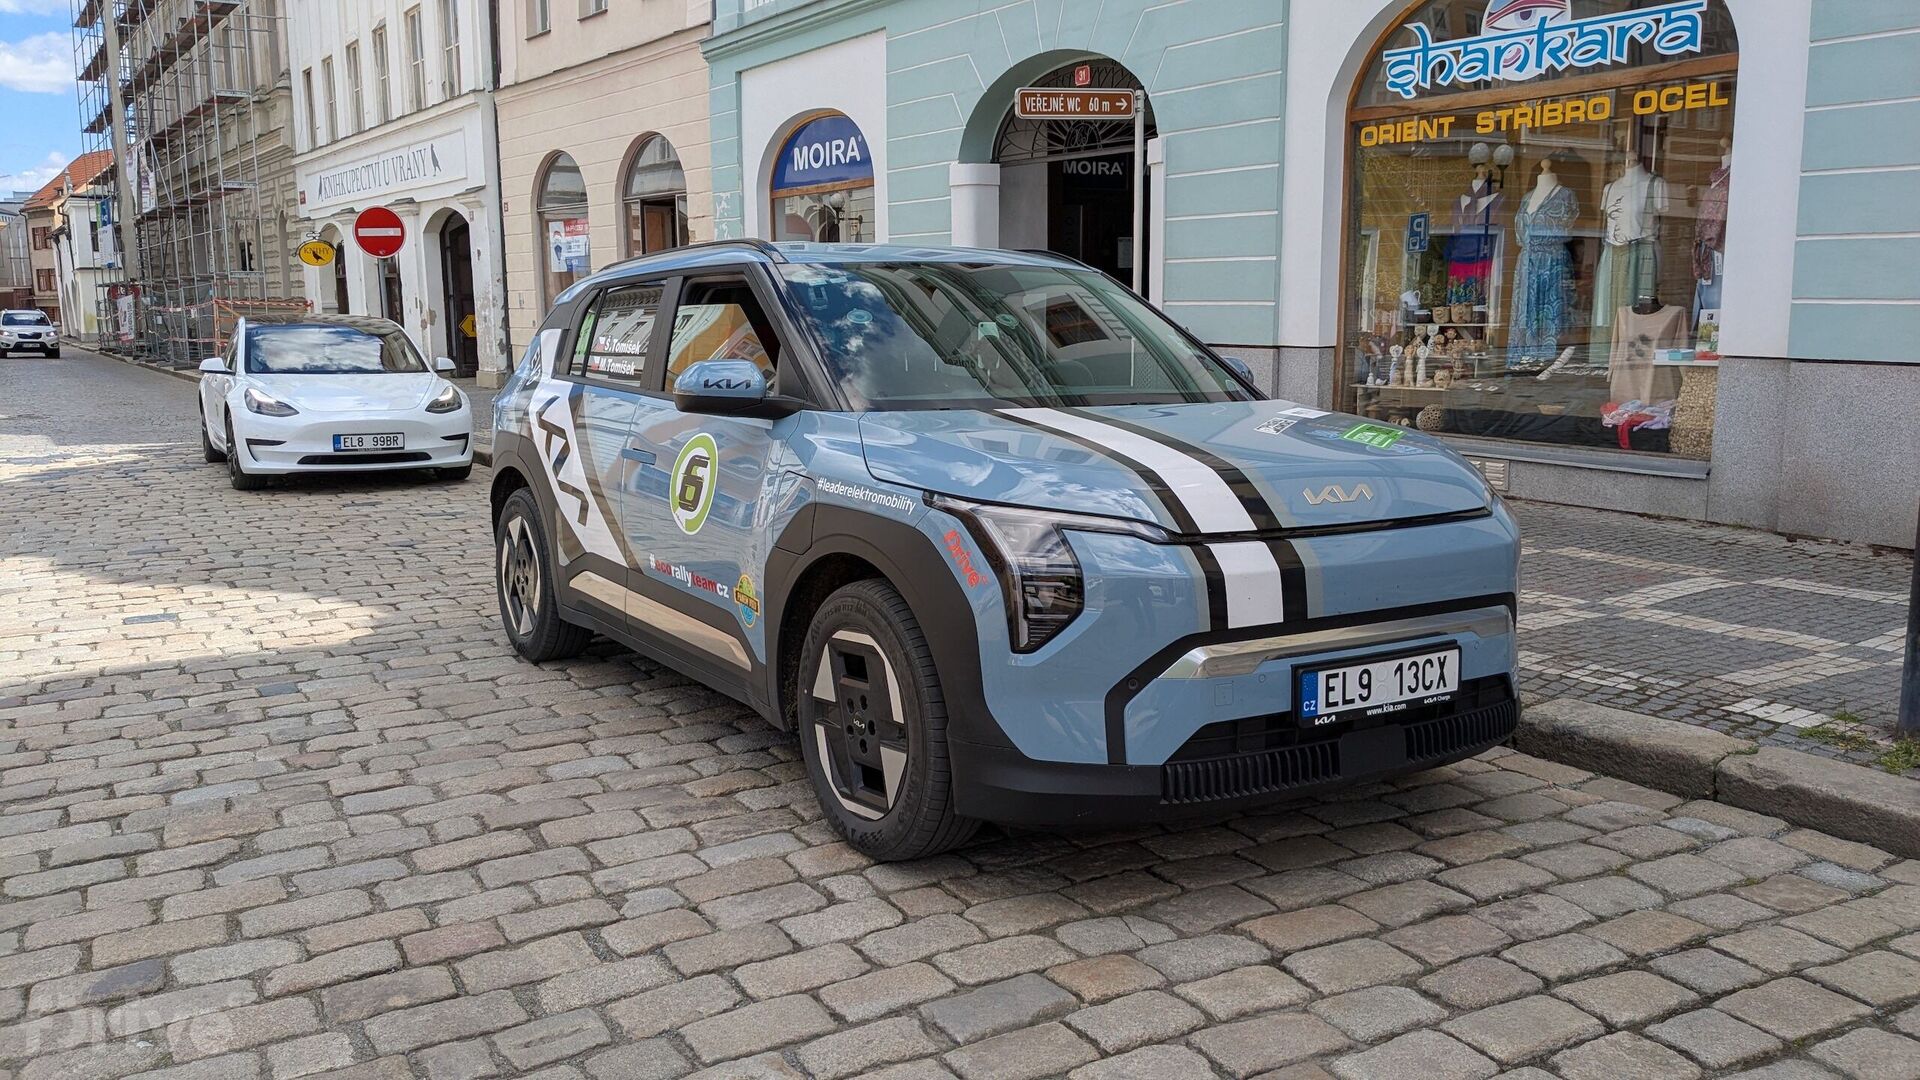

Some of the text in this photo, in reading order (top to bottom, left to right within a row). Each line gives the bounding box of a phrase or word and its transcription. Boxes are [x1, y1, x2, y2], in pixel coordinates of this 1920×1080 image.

[1384, 2, 1705, 97] shankara
[1079, 70, 1086, 81] 31
[1025, 94, 1110, 112] VEŘEJNÉ WC 60 m
[1360, 116, 1455, 147] ORIENT
[1633, 82, 1728, 115] OCEL
[381, 159, 390, 186] U
[391, 146, 428, 182] VRÁNY
[793, 136, 861, 171] MOIRA
[1063, 160, 1123, 176] MOIRA
[343, 435, 399, 448] EL8 99BR
[678, 454, 711, 513] 6
[817, 477, 917, 516] #leaderelektromobility
[649, 553, 730, 599] #ecorallyteamcz
[1324, 655, 1448, 709] EL9 13CX
[1303, 701, 1316, 712] CZ
[1366, 703, 1407, 716] www.kia.com
